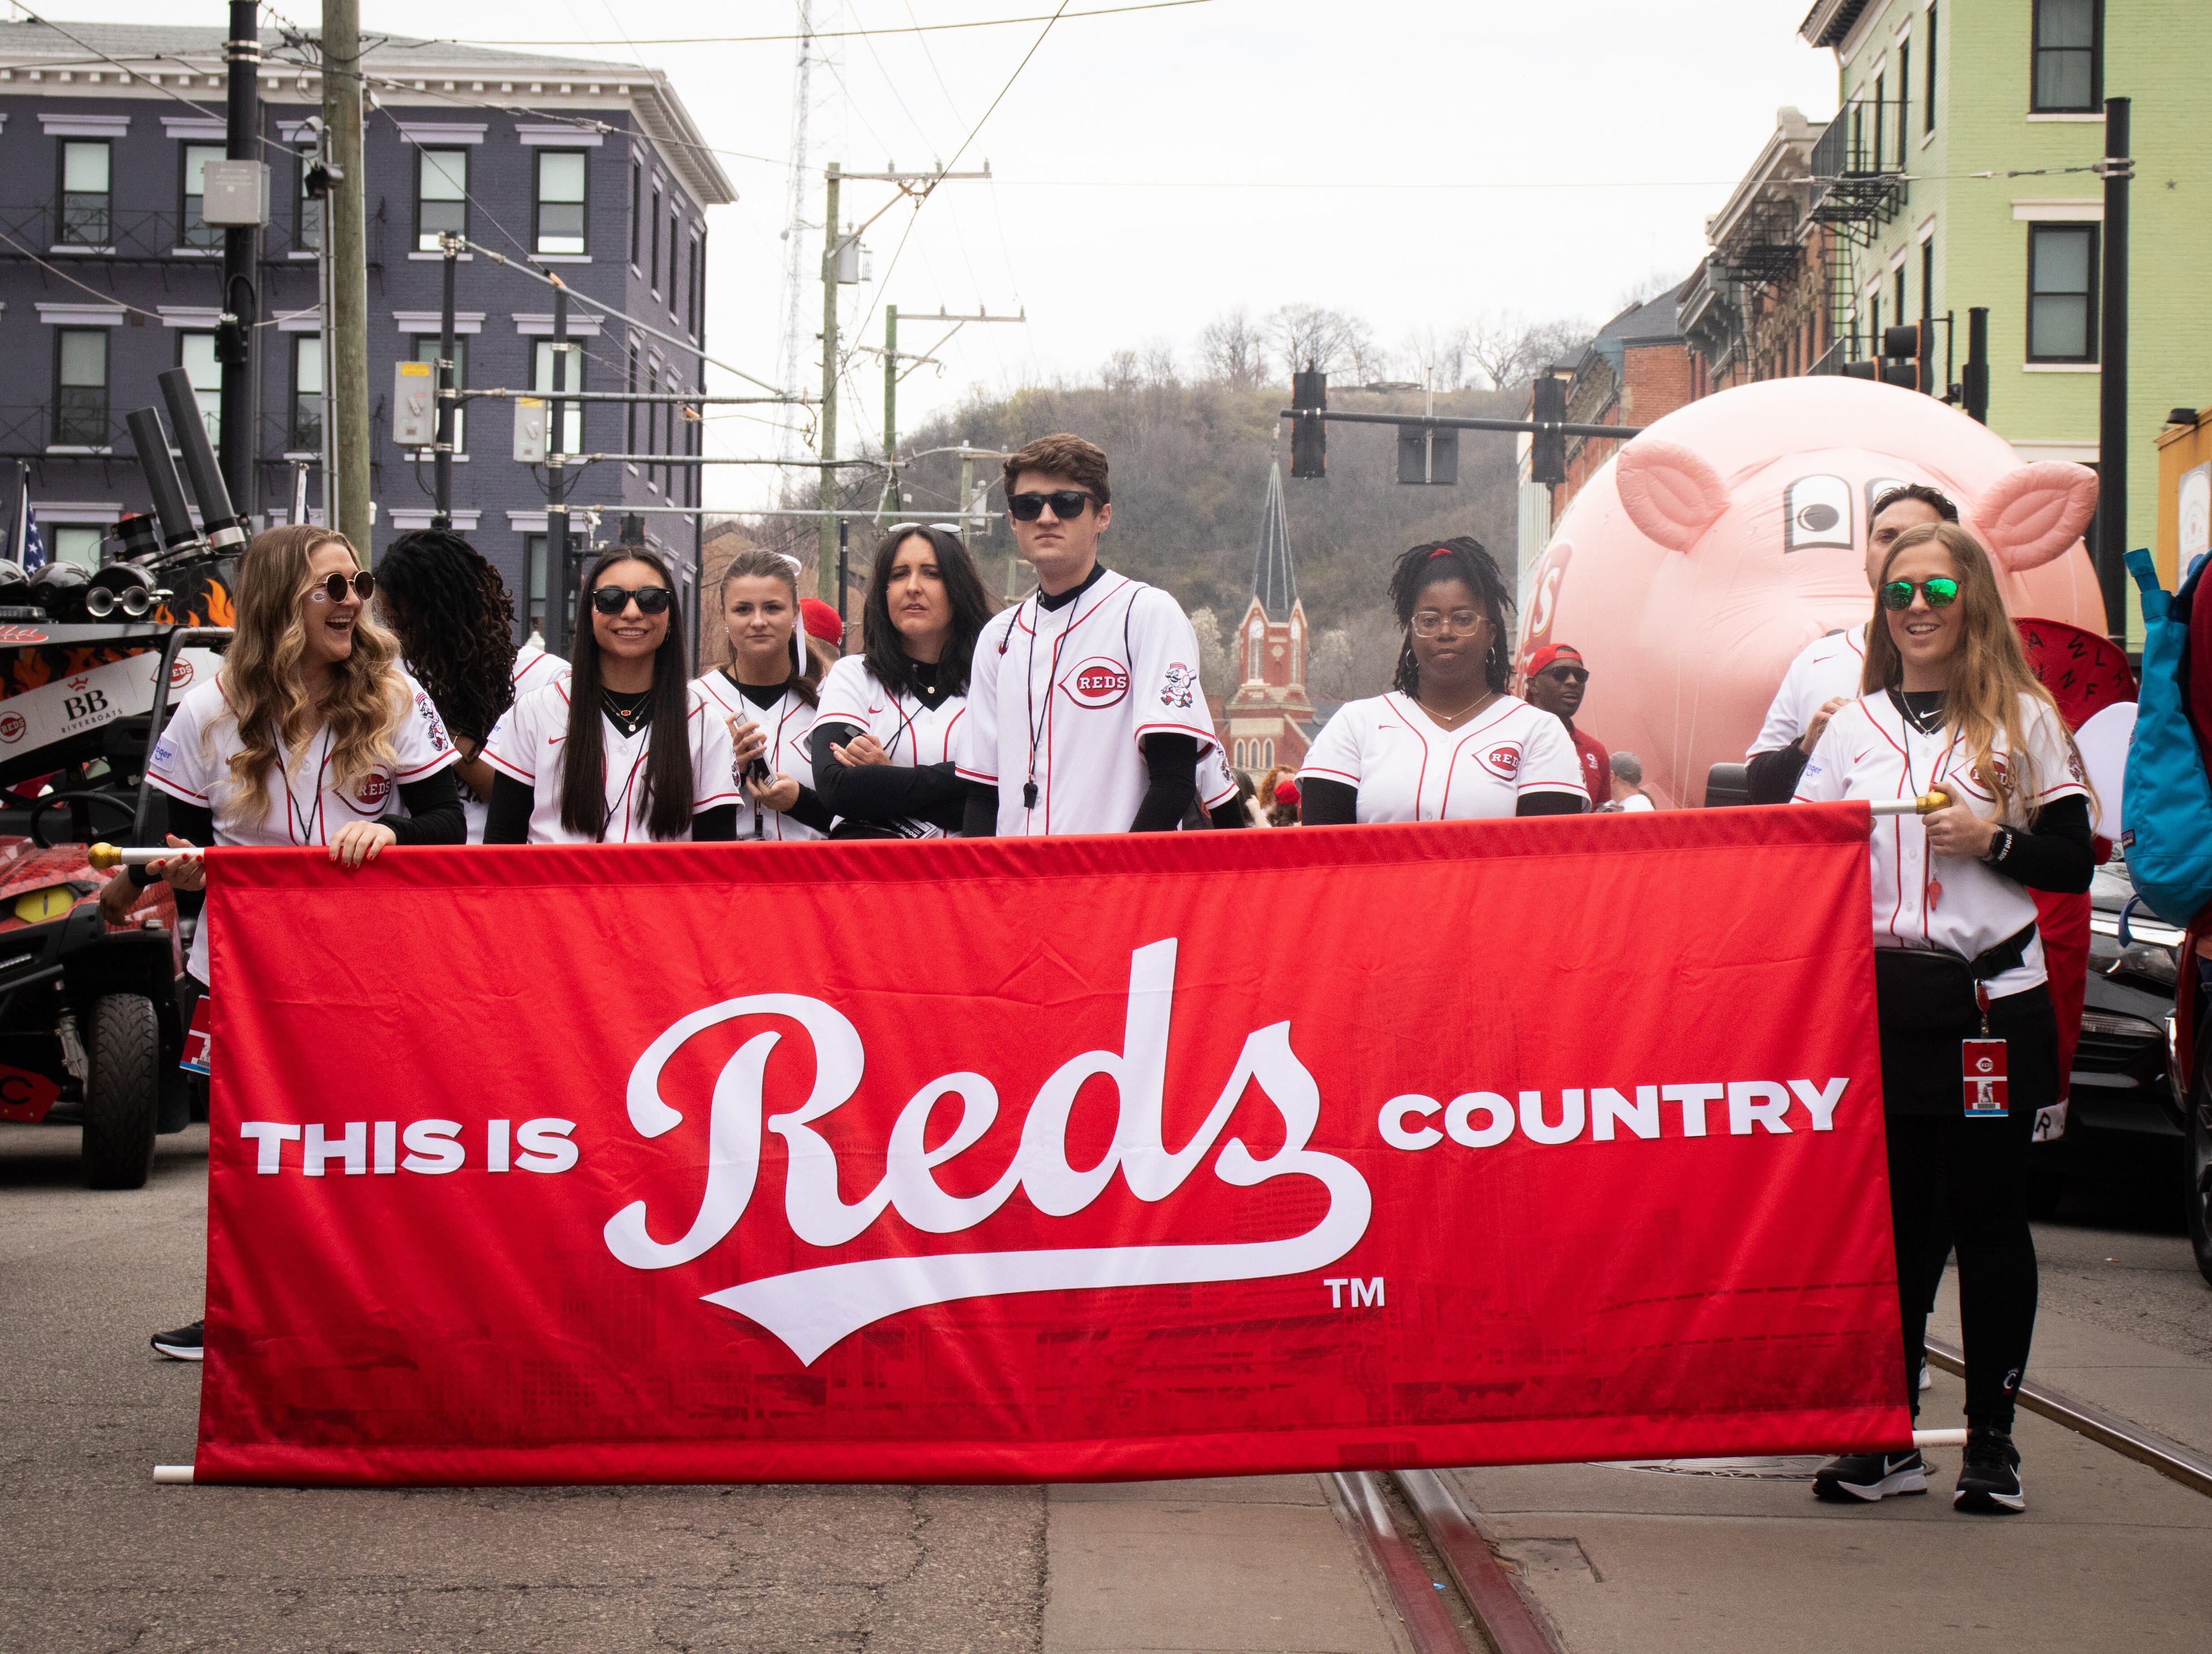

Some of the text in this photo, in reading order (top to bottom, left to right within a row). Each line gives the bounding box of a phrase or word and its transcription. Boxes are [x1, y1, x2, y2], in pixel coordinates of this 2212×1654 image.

[173, 665, 192, 677] EDS
[1079, 676, 1127, 690] REDS
[63, 690, 108, 721] BB
[1, 718, 24, 733] REDS
[61, 708, 122, 733] RIVERBOATS
[1491, 753, 1519, 768] RED
[241, 938, 1848, 1366] THIS IS Reds COUNTRY
[1323, 1277, 1385, 1309] TM
